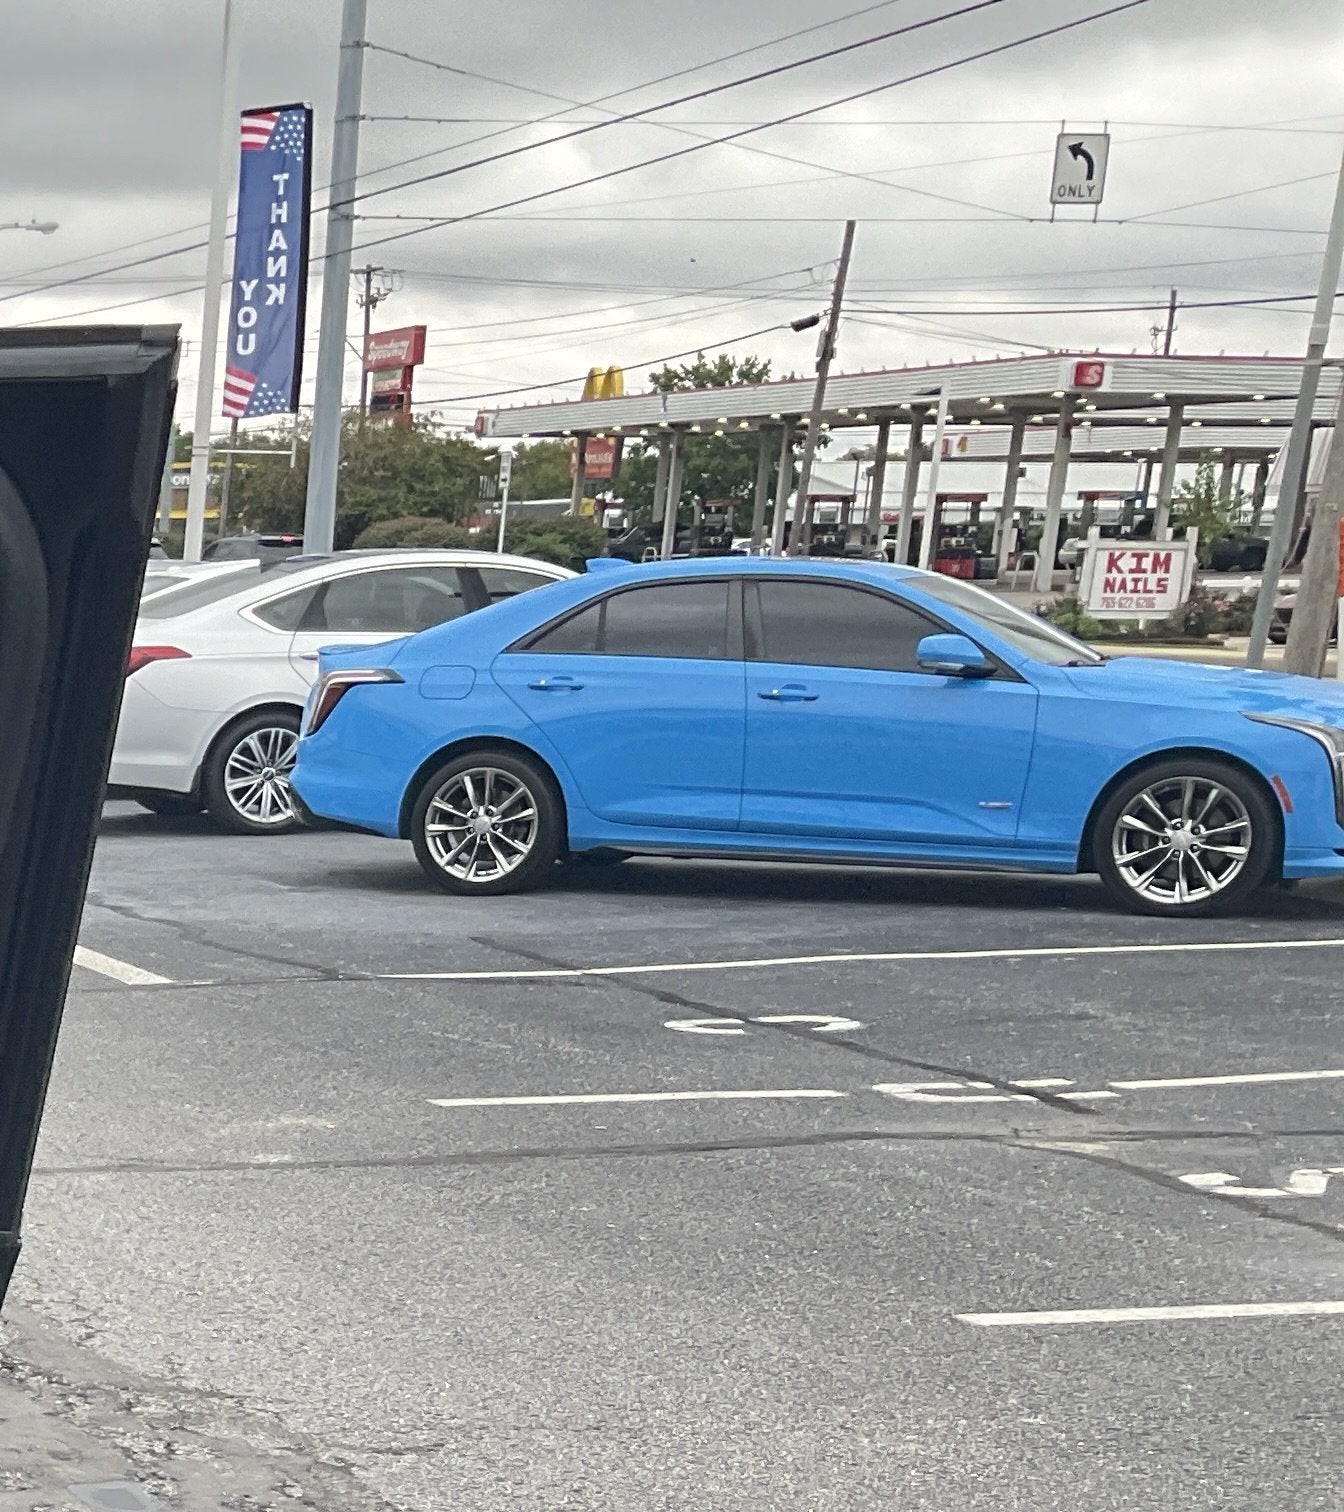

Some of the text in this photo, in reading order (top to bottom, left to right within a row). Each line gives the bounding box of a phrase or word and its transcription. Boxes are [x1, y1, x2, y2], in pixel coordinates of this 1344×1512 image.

[1057, 184, 1096, 198] ONLY
[1106, 552, 1172, 574] KIM
[1103, 577, 1169, 594] NAILS
